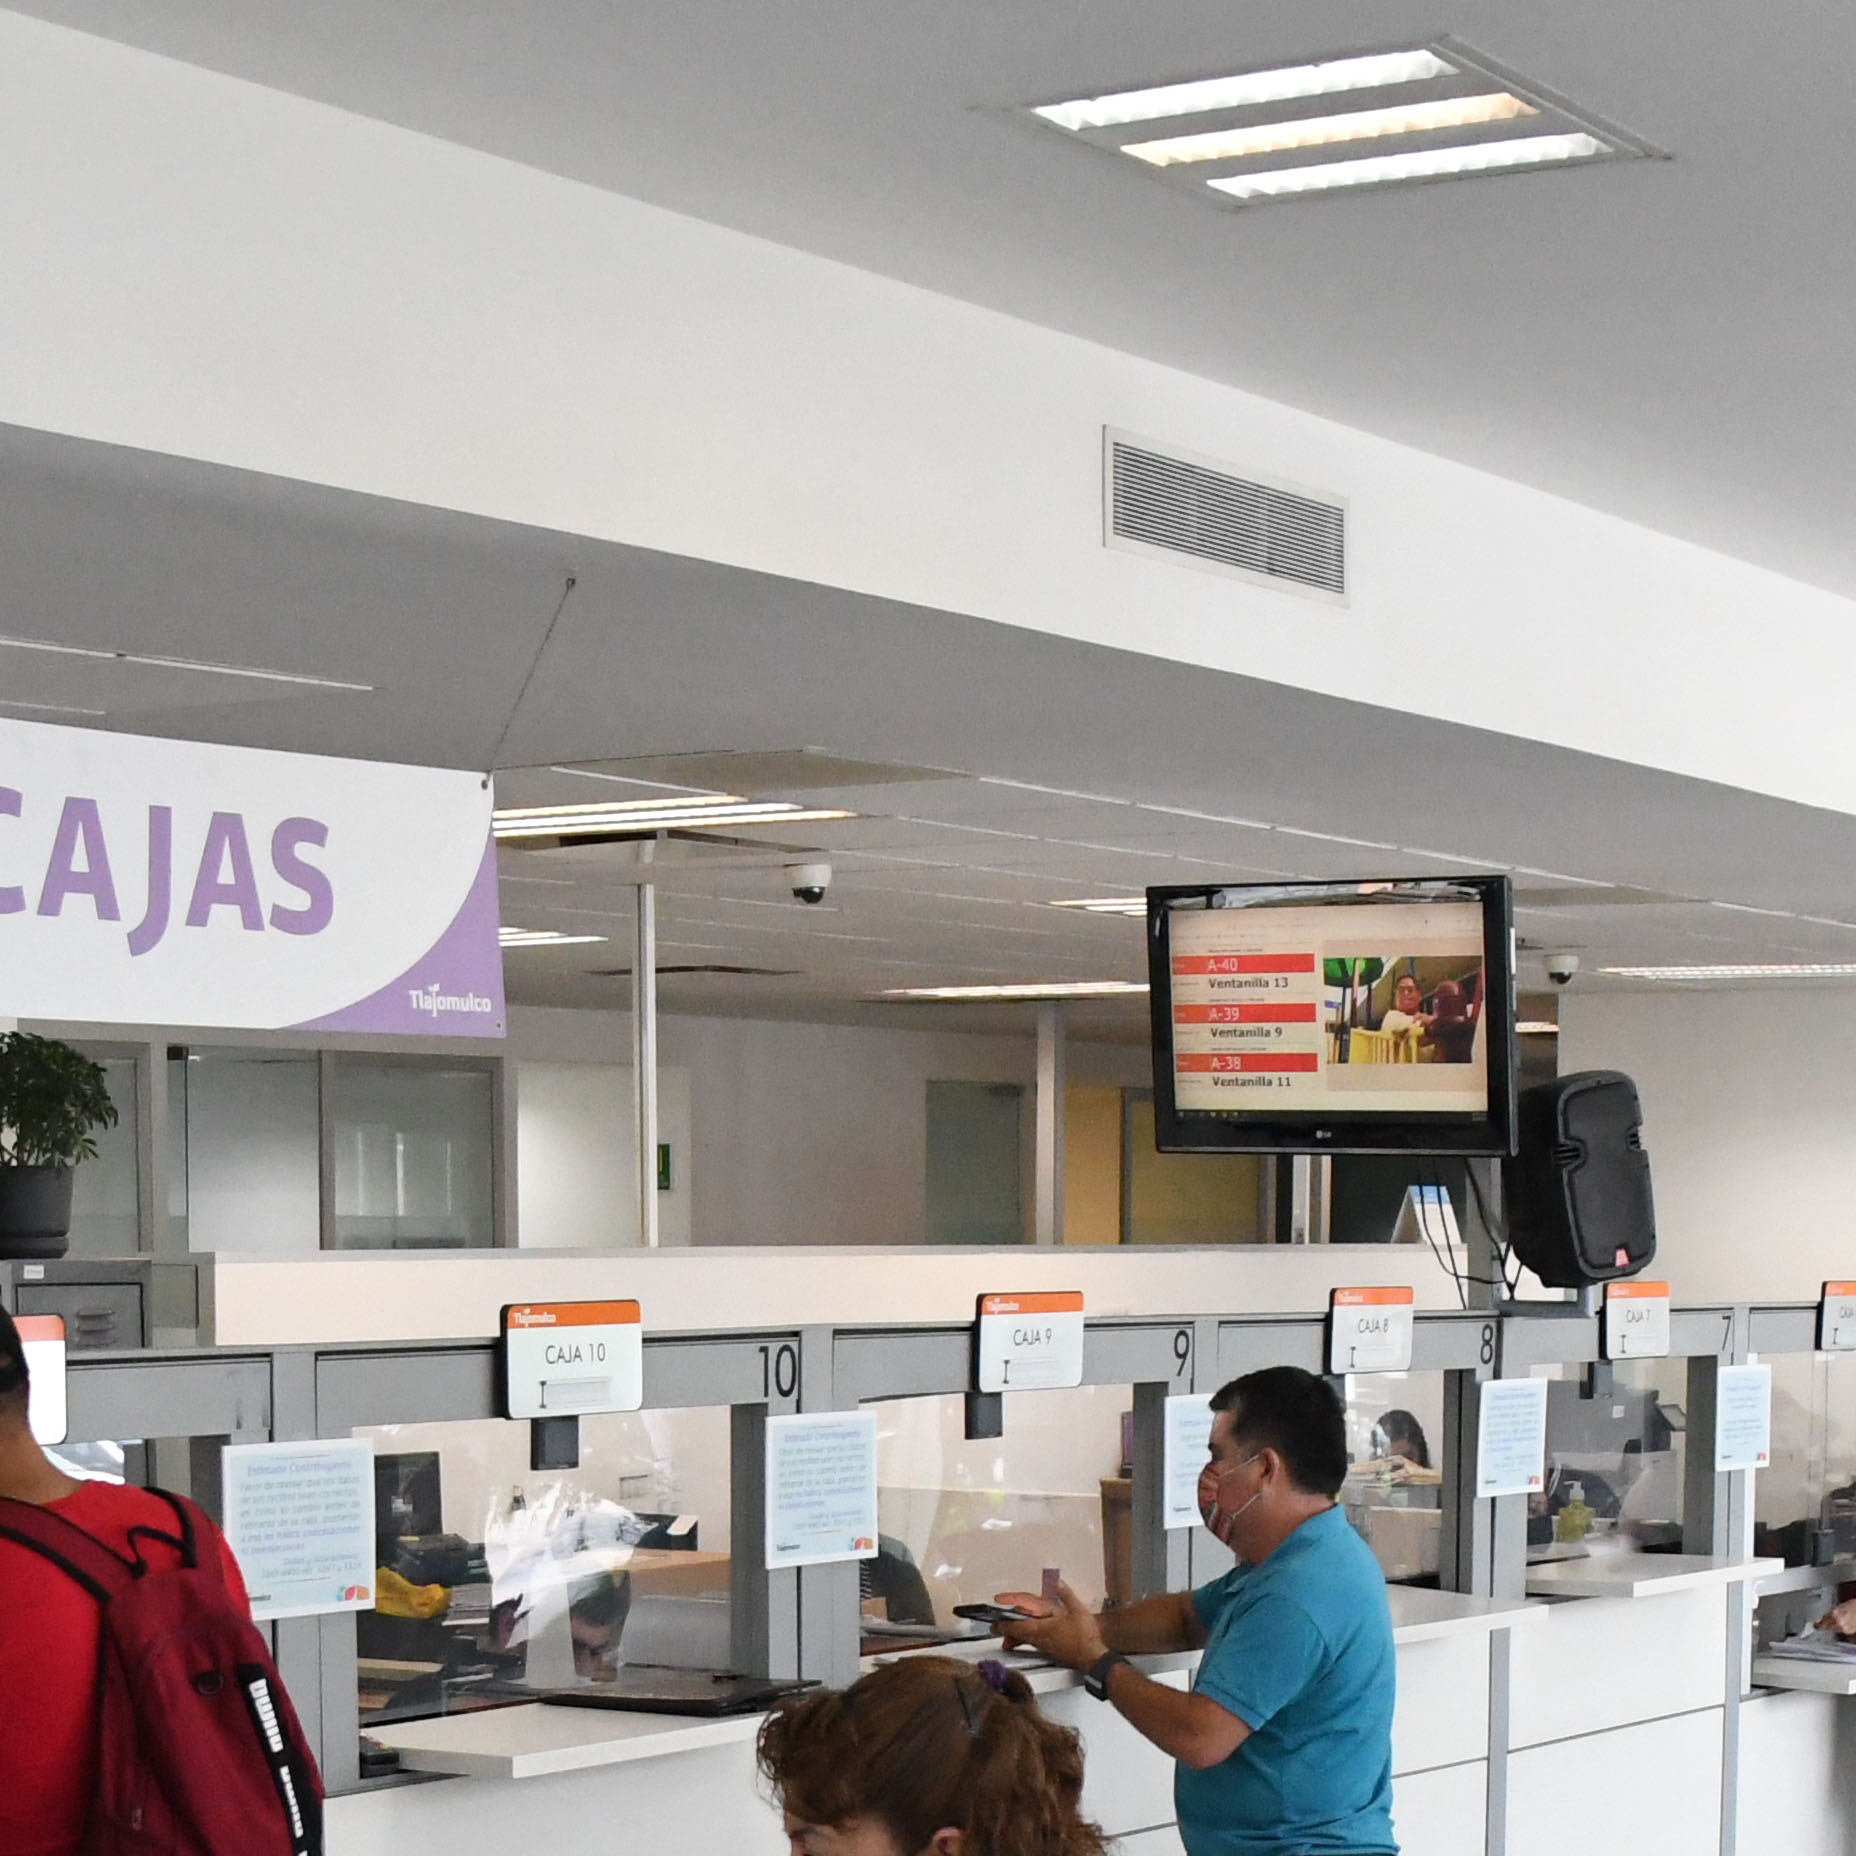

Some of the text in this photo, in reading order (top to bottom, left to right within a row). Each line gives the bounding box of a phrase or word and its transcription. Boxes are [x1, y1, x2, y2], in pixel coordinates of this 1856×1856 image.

[1208, 957, 1239, 972] A-40
[1208, 977, 1289, 989] Ventanilla 13
[408, 983, 492, 1018] Tlajomulco
[1208, 1007, 1240, 1021] A-39
[1210, 1027, 1283, 1038] Ventanilla 9
[1210, 1056, 1242, 1070] A-38
[1212, 1076, 1292, 1087] Ventanilla 11
[1358, 1319, 1382, 1333] CAJA
[1722, 1315, 1732, 1351] 7
[1013, 1327, 1052, 1346] CAJA 9
[1480, 1324, 1493, 1365] 8
[545, 1343, 606, 1365] CAJA 10
[1173, 1329, 1190, 1377] 9
[758, 1344, 796, 1398] 10
